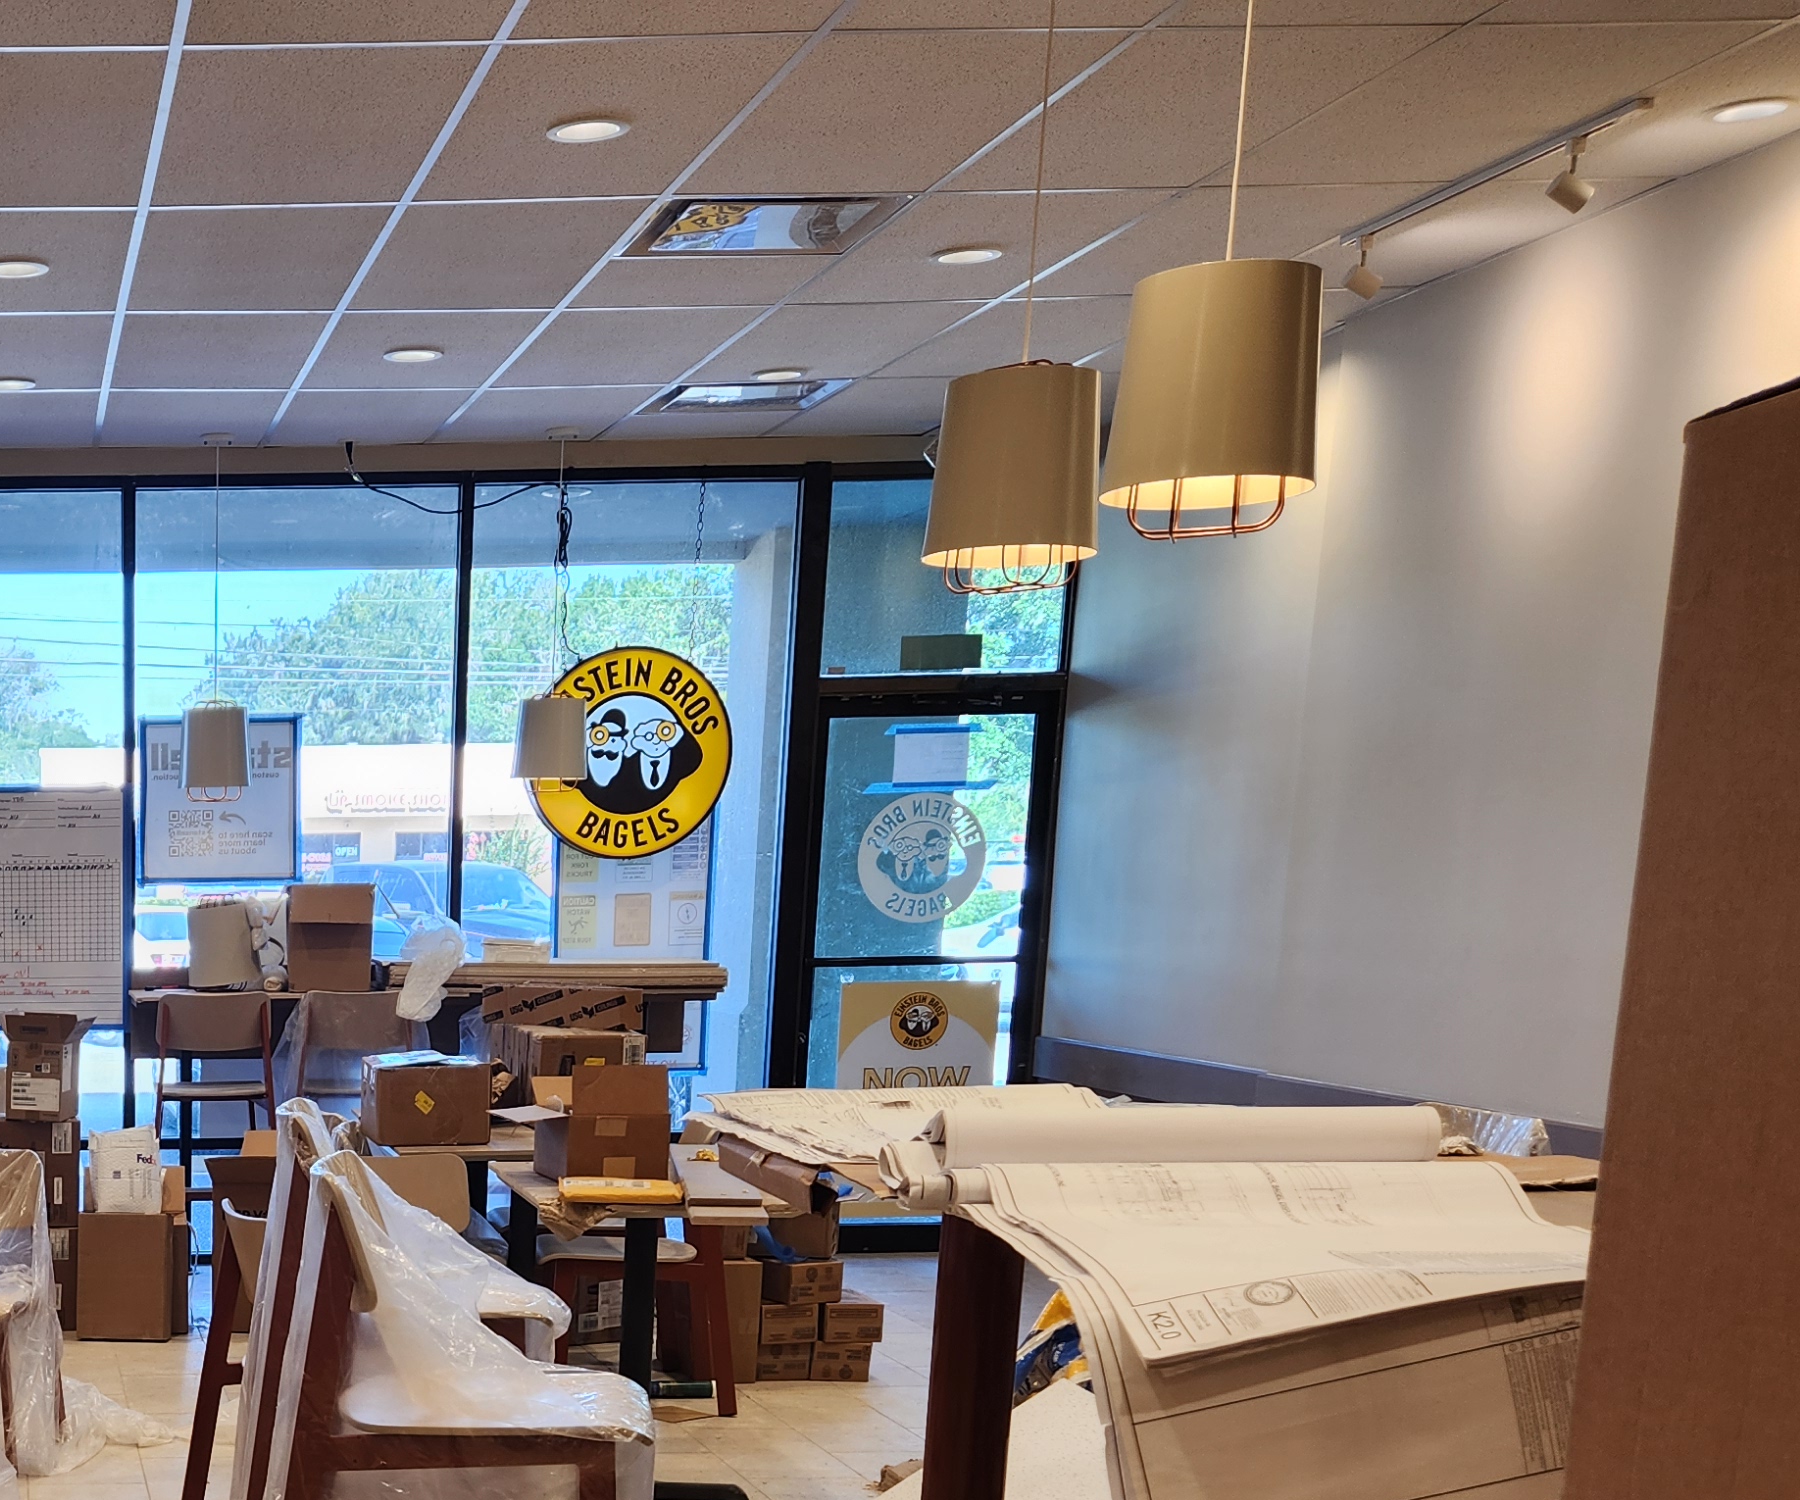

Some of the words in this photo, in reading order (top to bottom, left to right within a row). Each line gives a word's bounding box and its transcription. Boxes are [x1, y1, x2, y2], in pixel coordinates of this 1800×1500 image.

[565, 658, 653, 702] STEIN
[659, 666, 719, 735] BROS
[576, 807, 680, 849] BAGELS
[335, 846, 358, 857] OPEN
[510, 1003, 524, 1015] USG
[894, 994, 927, 1017] EINSTEIN
[928, 997, 946, 1018] BROS
[569, 1010, 584, 1021] USG
[902, 1035, 933, 1048] BAGELS
[862, 1065, 972, 1089] NOW
[136, 1153, 157, 1166] Fed
[1146, 1310, 1182, 1341] K2.0
